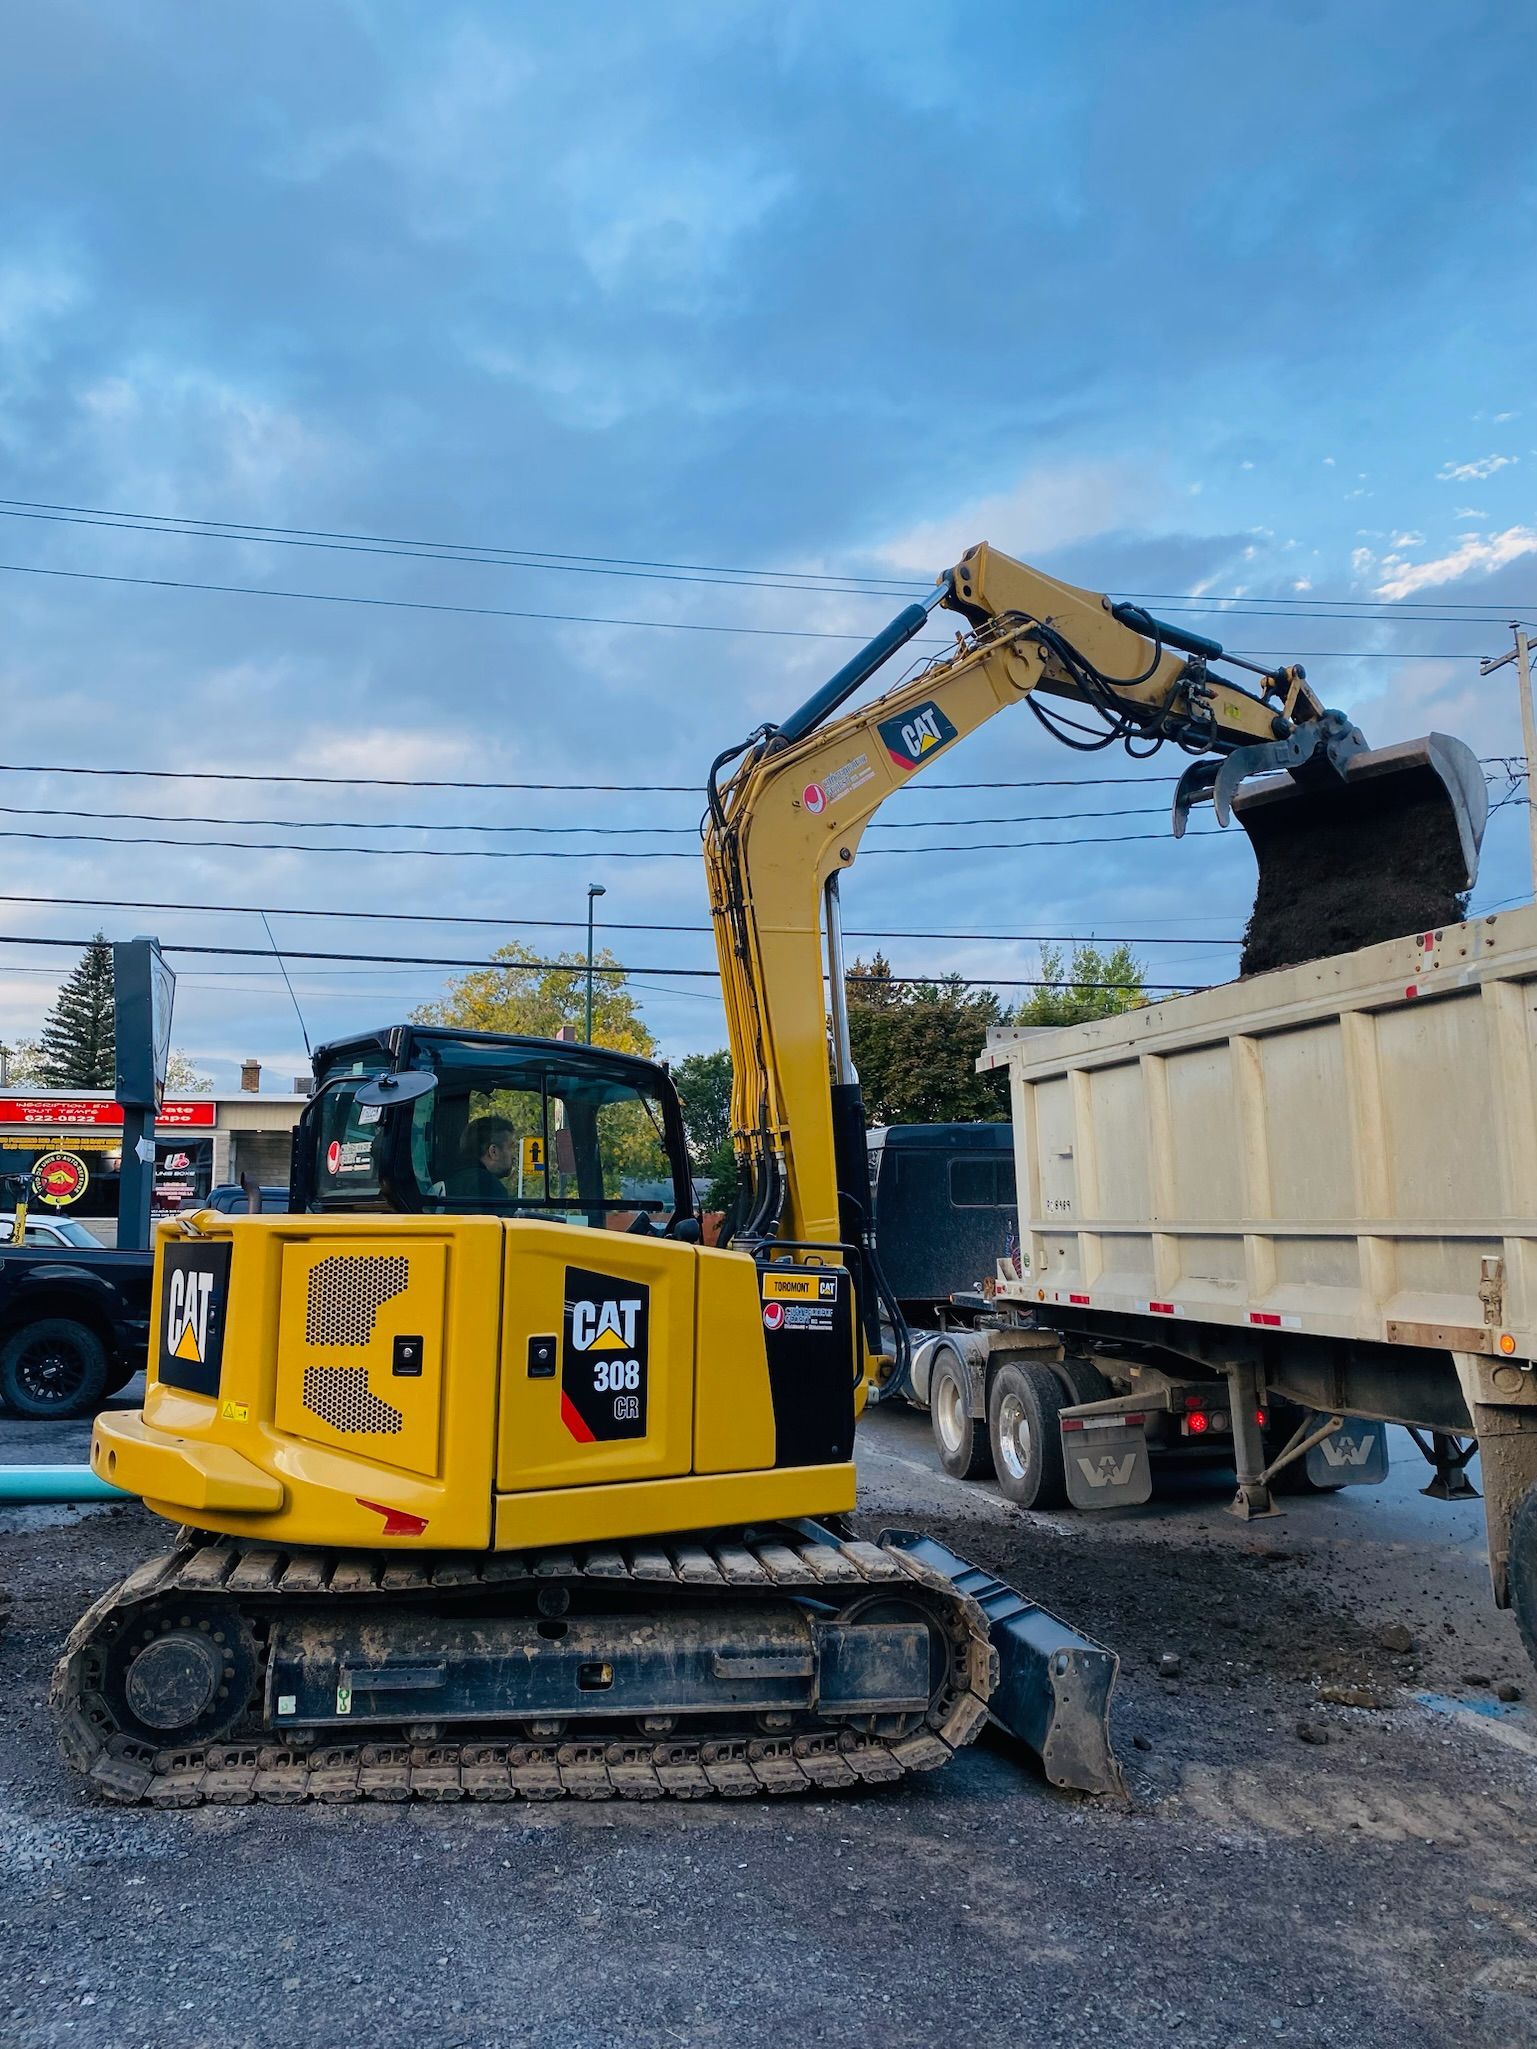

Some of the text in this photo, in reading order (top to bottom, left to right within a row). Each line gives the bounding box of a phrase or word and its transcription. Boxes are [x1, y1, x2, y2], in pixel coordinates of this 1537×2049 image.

[901, 708, 941, 758] CAT
[774, 1282, 835, 1295] TOROMONT CAT
[168, 1269, 214, 1363] CAT
[572, 1300, 641, 1350] CAT
[593, 1360, 640, 1392] 308
[613, 1396, 639, 1420] CR
